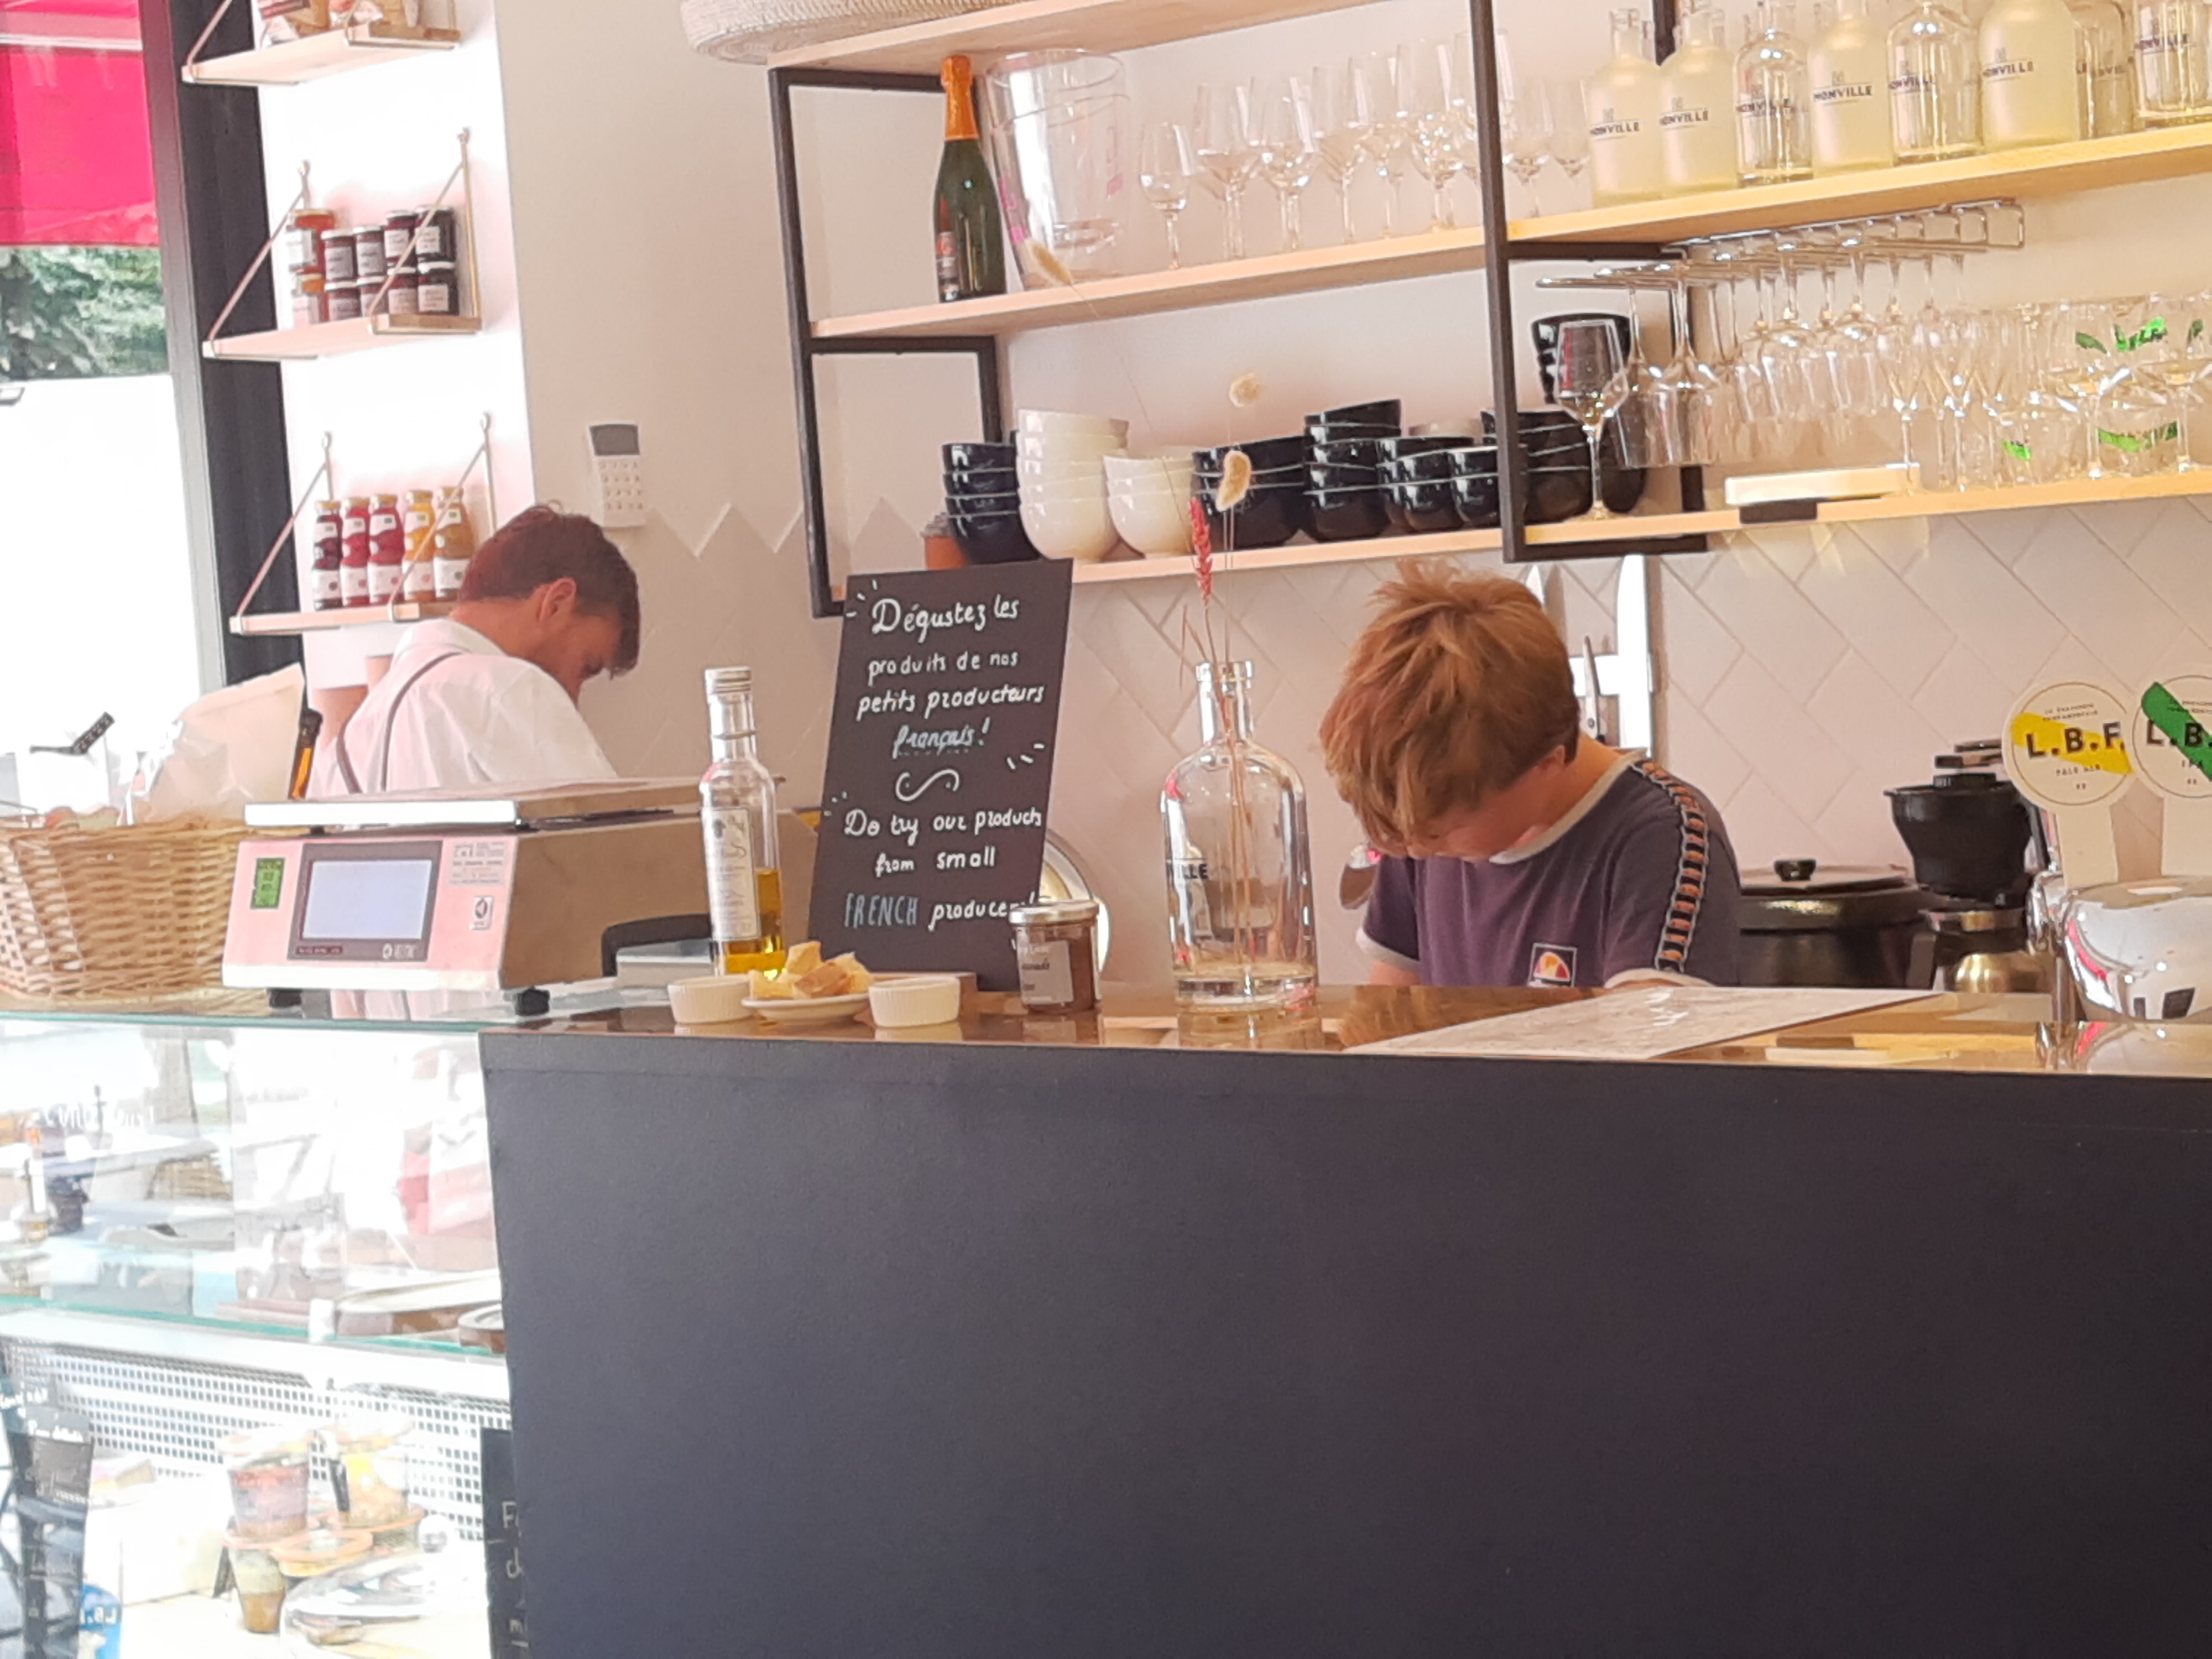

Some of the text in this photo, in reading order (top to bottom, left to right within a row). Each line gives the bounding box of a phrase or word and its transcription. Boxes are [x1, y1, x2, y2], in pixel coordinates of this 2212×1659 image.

[872, 594, 1019, 643] Dégustez les
[868, 651, 1018, 687] produits de nos
[856, 684, 1045, 722] petits producteurs
[844, 807, 1042, 846] Do try our products
[875, 844, 996, 878] from small
[844, 892, 919, 929] FRENCH
